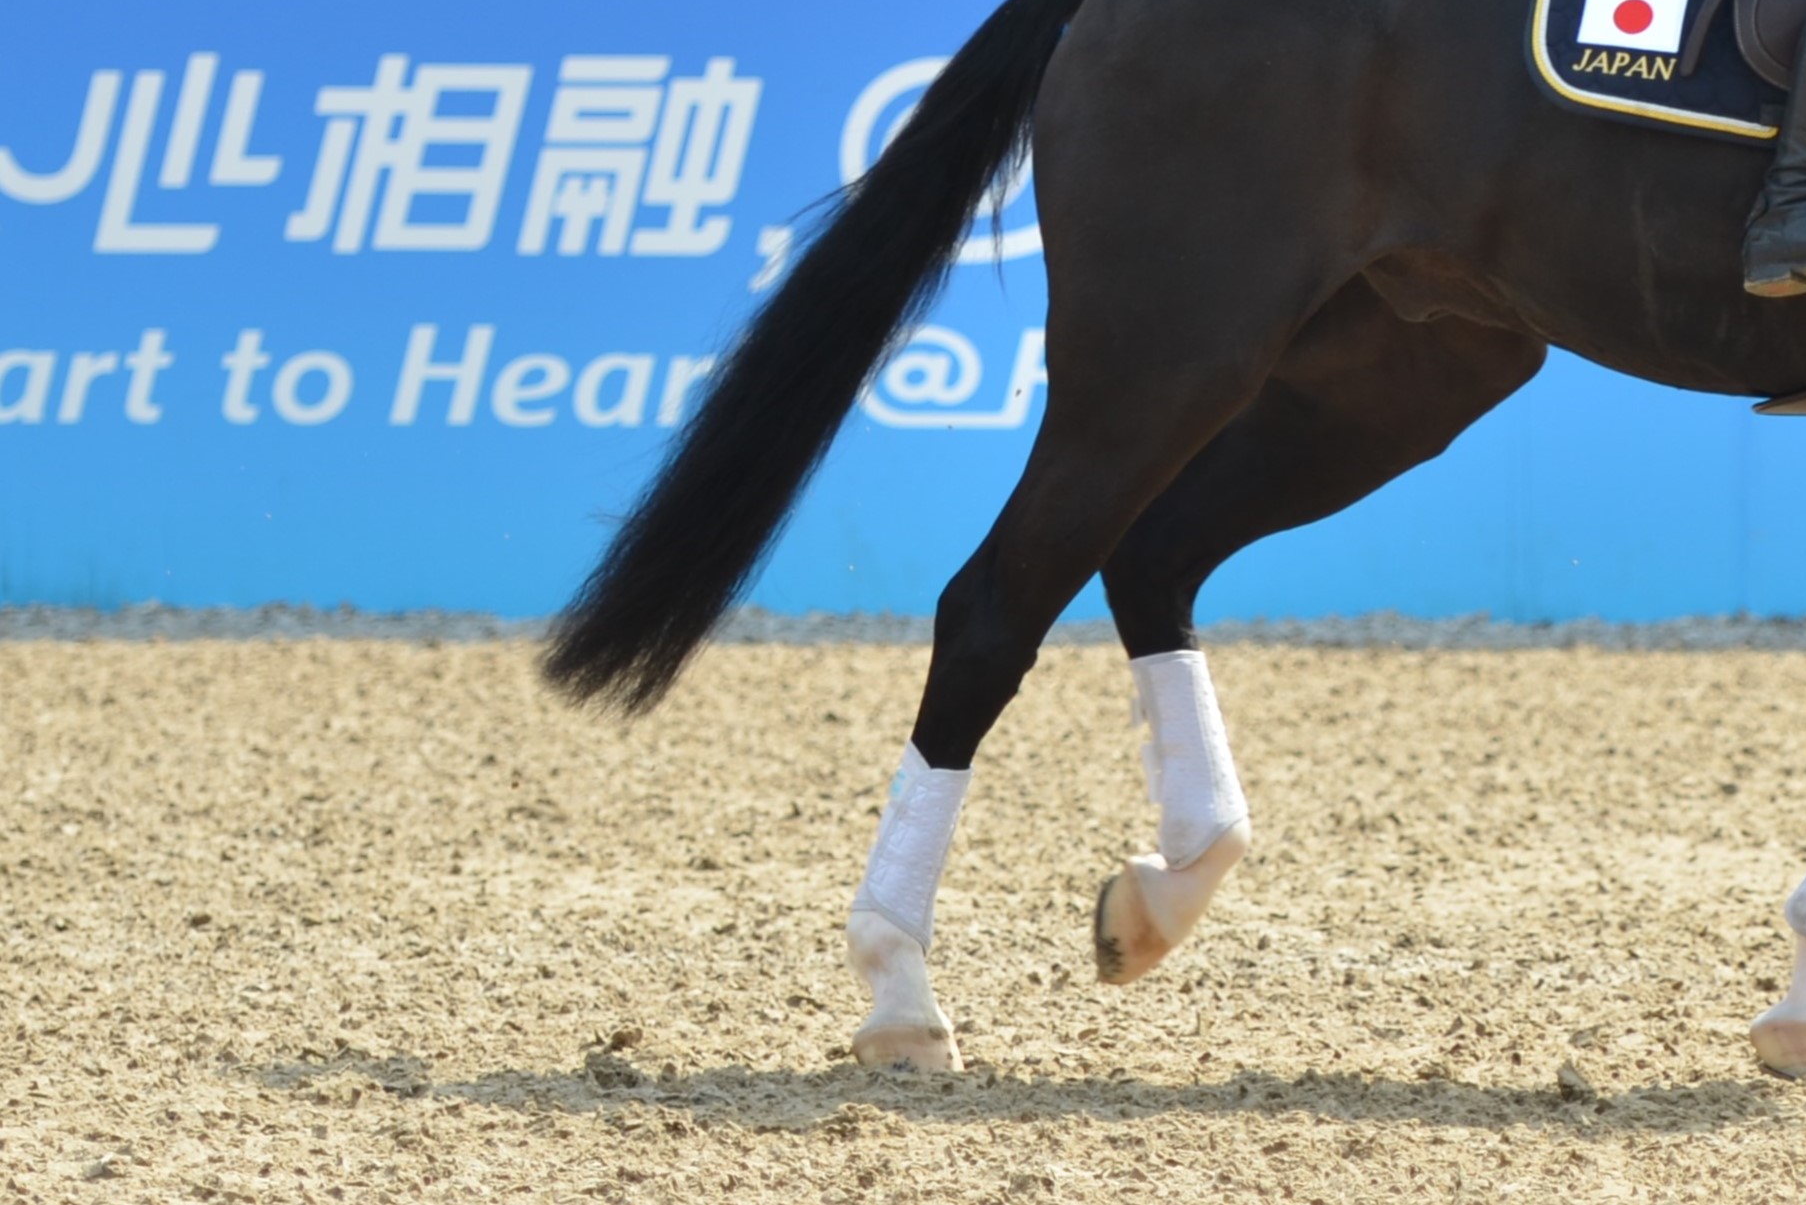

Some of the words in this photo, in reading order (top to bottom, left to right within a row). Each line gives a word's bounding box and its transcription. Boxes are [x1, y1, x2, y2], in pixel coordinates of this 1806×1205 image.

[1572, 48, 1678, 82] JAPAN
[0, 327, 174, 424] art
[221, 328, 354, 426] to
[389, 323, 718, 427] Hear
